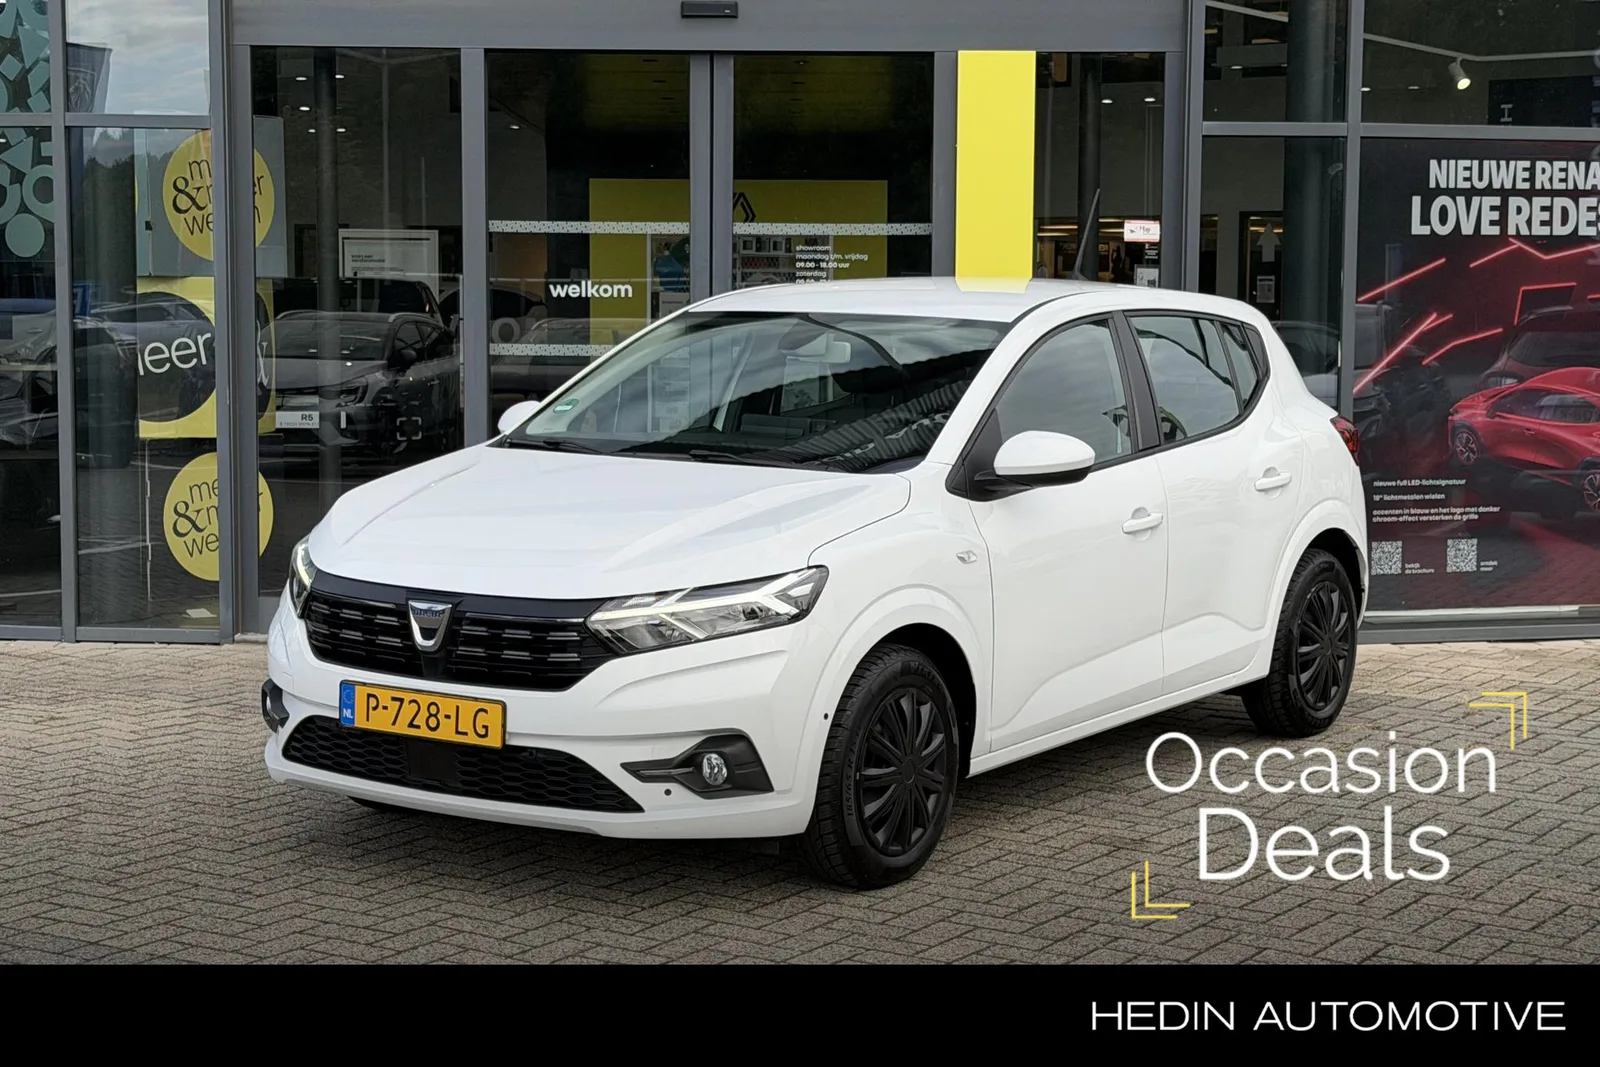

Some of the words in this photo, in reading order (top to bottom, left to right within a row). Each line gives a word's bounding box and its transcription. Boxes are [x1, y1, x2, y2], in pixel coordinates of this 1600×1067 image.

[1429, 159, 1531, 189] NIEUWE
[1535, 160, 1600, 190] RENA
[1411, 195, 1502, 236] LOVE
[1507, 196, 1600, 236] REDE
[844, 253, 868, 261] vrijdag
[549, 280, 633, 298] welkom
[301, 413, 314, 421] R5
[1407, 479, 1466, 487] LED-lichtsignatuur
[1372, 508, 1403, 516] accenten
[1450, 506, 1465, 514] logo
[1372, 515, 1418, 523] chroom-effect
[1462, 514, 1479, 522] grille
[342, 707, 354, 719] NL
[366, 692, 490, 739] P-728-LG
